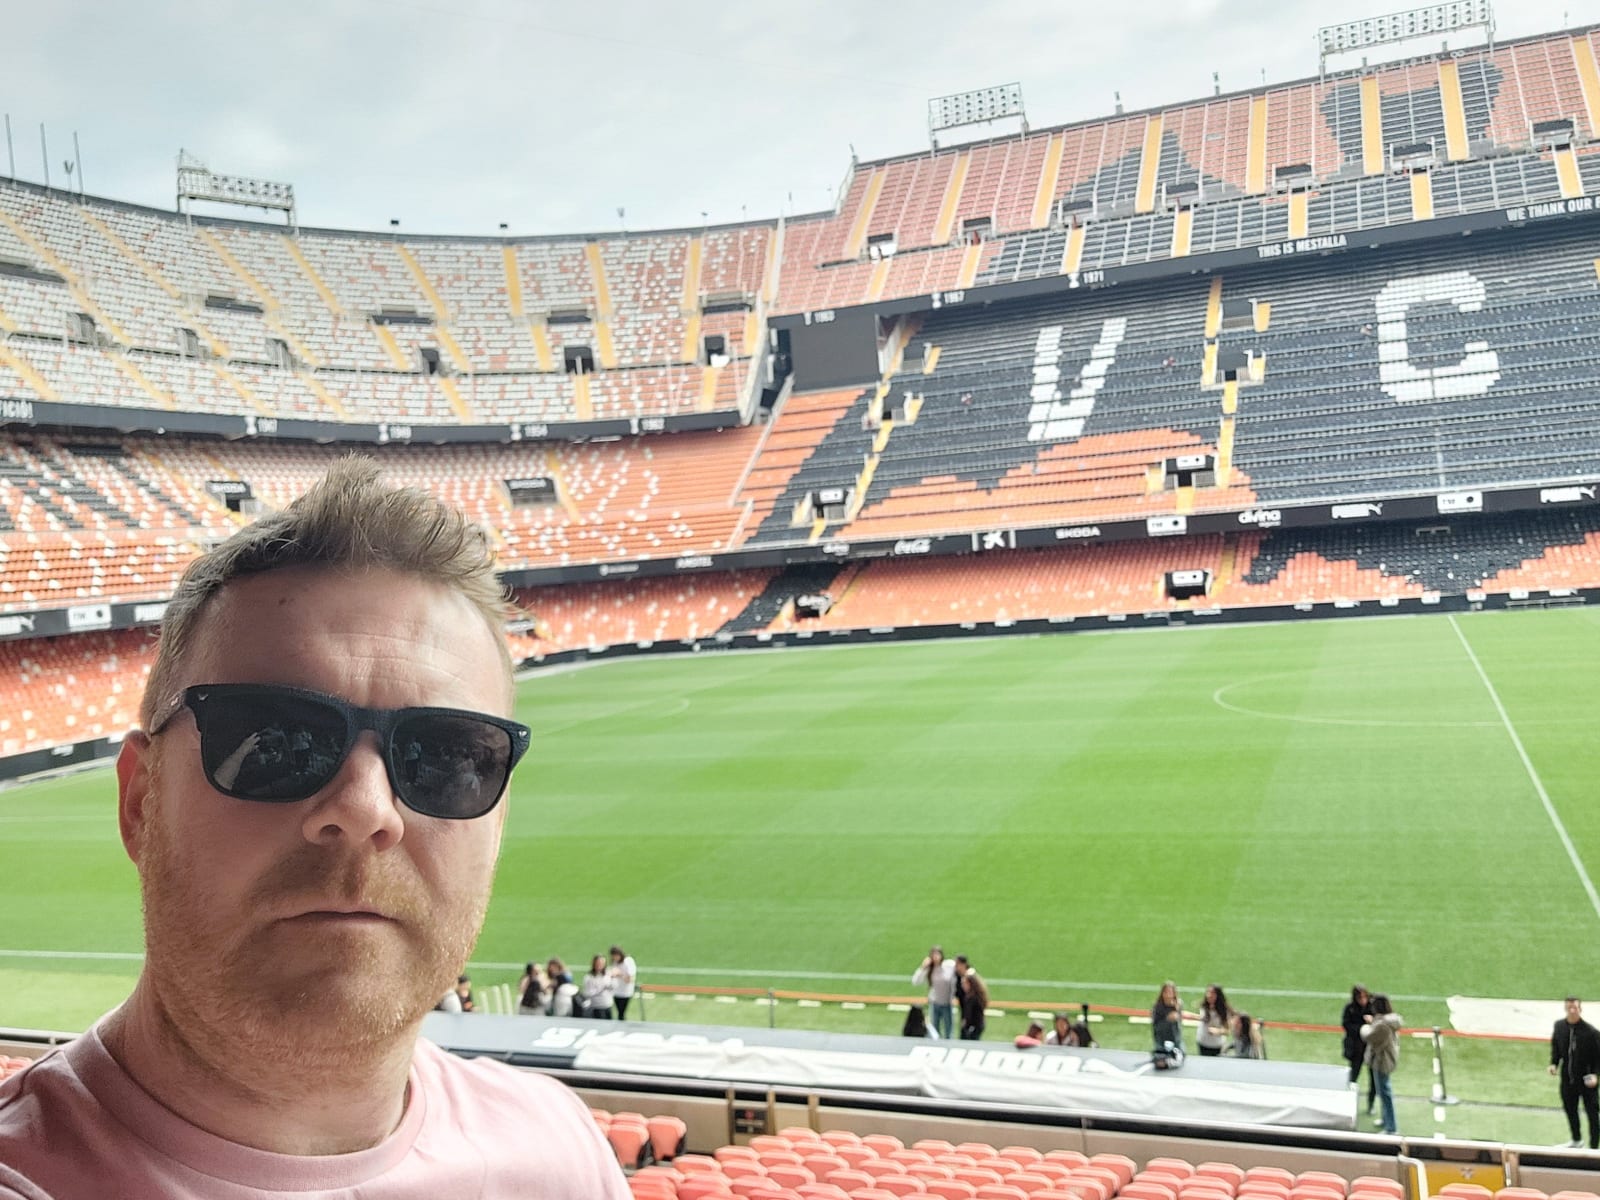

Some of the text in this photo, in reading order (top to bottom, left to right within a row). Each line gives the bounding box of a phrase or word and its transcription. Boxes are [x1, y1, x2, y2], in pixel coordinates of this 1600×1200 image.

[1506, 207, 1526, 222] WE
[1528, 201, 1566, 218] THANK
[1568, 198, 1592, 212] OUR
[1258, 234, 1347, 258] THIS IS MESTALLA
[1375, 271, 1500, 403] C
